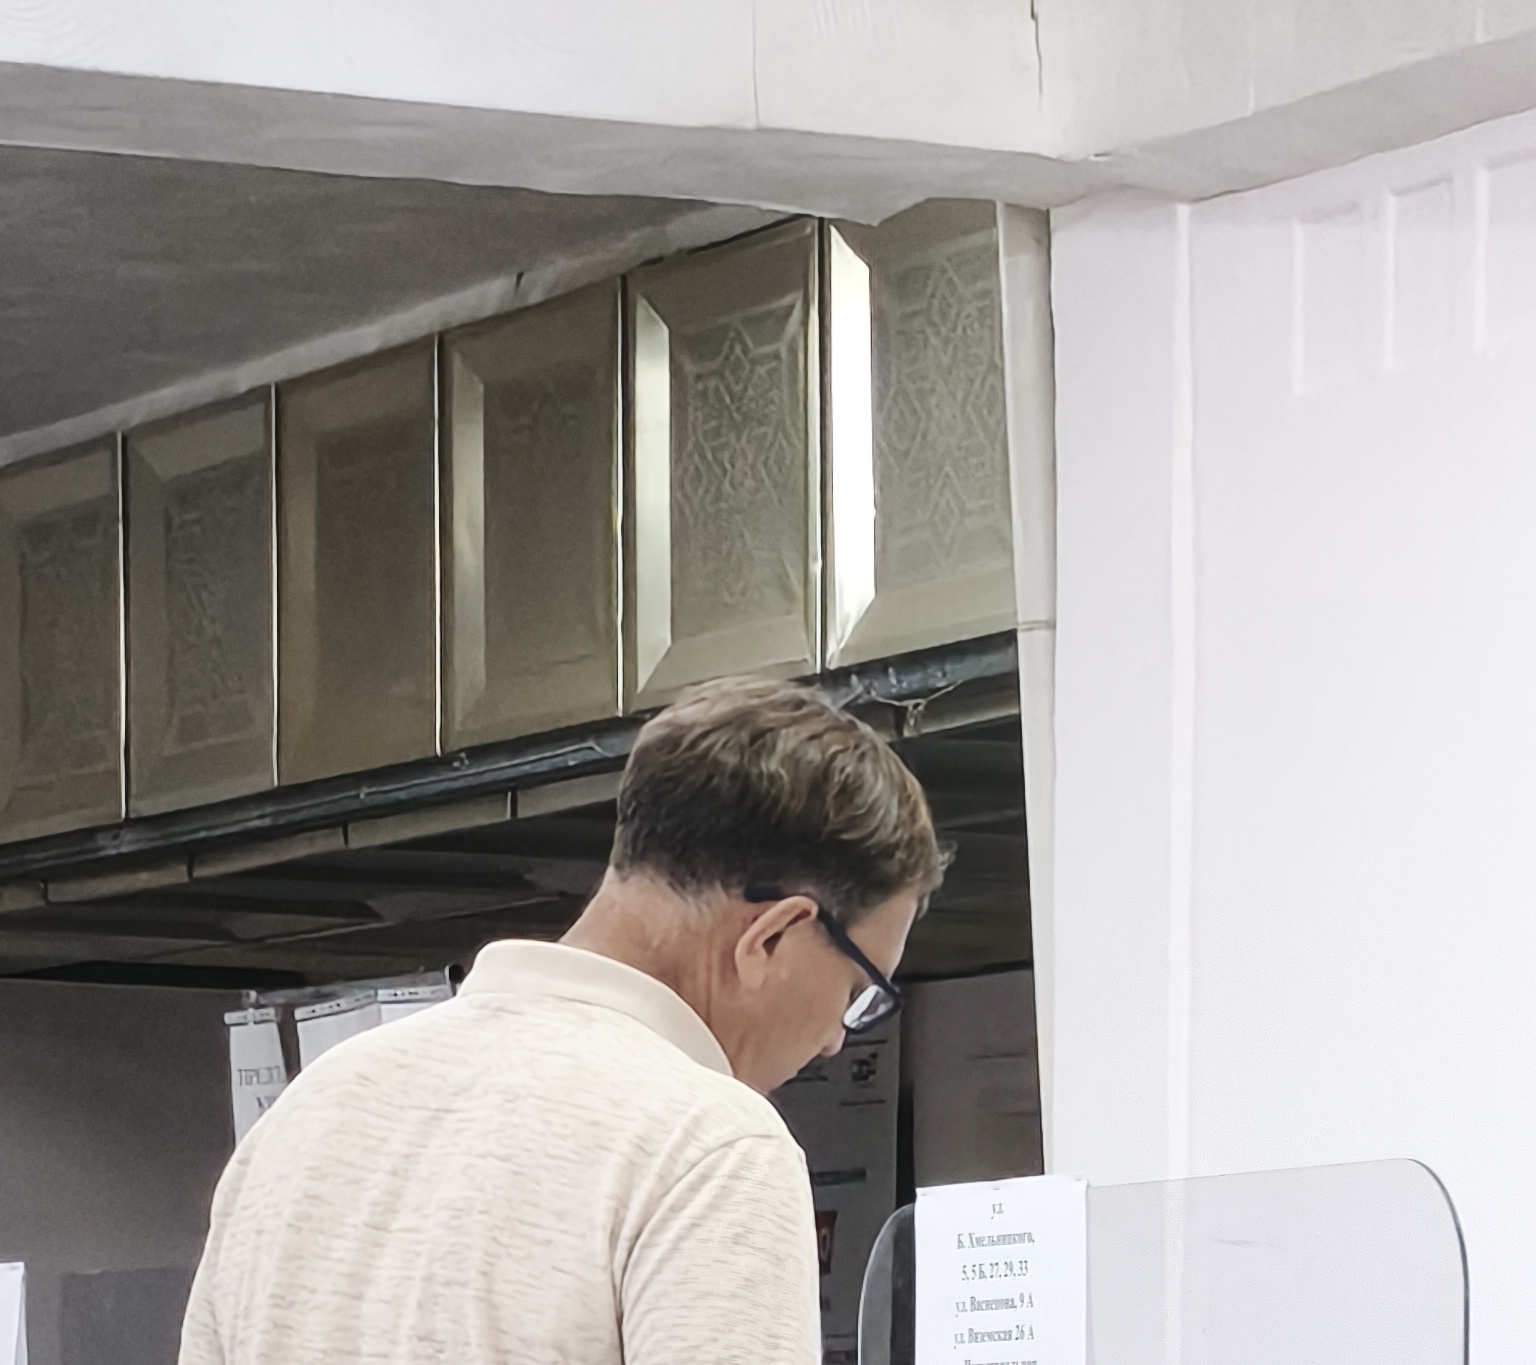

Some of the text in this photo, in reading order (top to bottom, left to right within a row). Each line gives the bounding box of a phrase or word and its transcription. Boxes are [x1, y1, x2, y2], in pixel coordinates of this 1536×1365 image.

[1017, 1259, 1029, 1277] 33
[1014, 1323, 1026, 1342] 26
[1027, 1323, 1035, 1341] А
